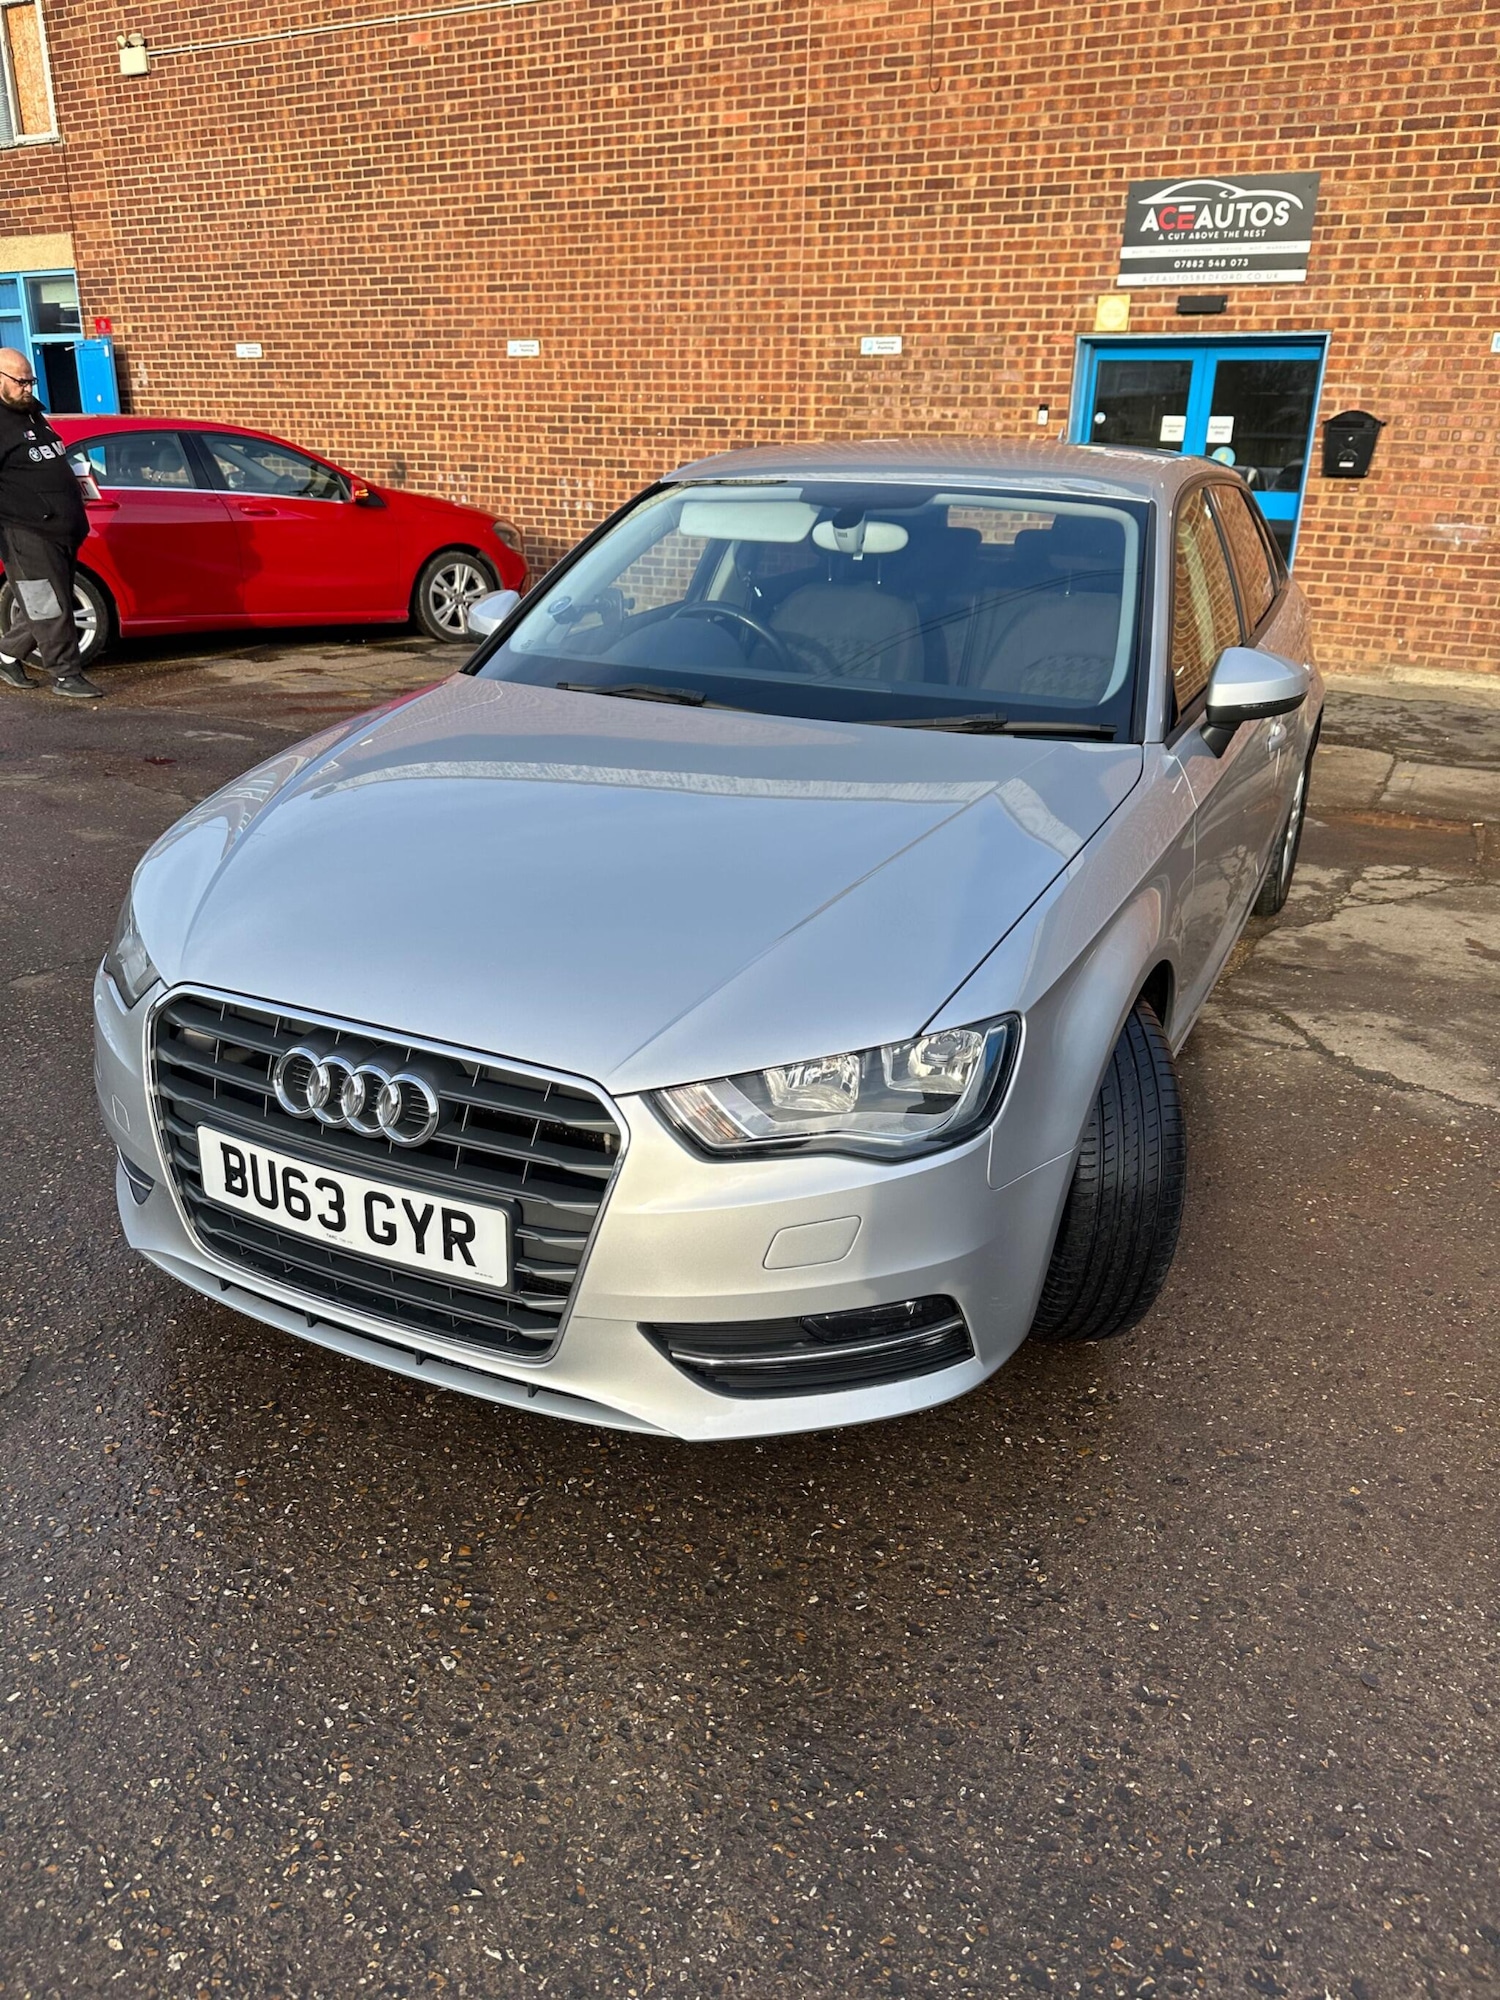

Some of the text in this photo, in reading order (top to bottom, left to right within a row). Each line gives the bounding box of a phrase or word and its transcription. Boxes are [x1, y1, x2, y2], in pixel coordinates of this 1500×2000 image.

[1158, 229, 1267, 241] A CUT ABOVE THE REST
[1230, 258, 1249, 267] 073
[220, 1142, 477, 1268] BU63 GYR
